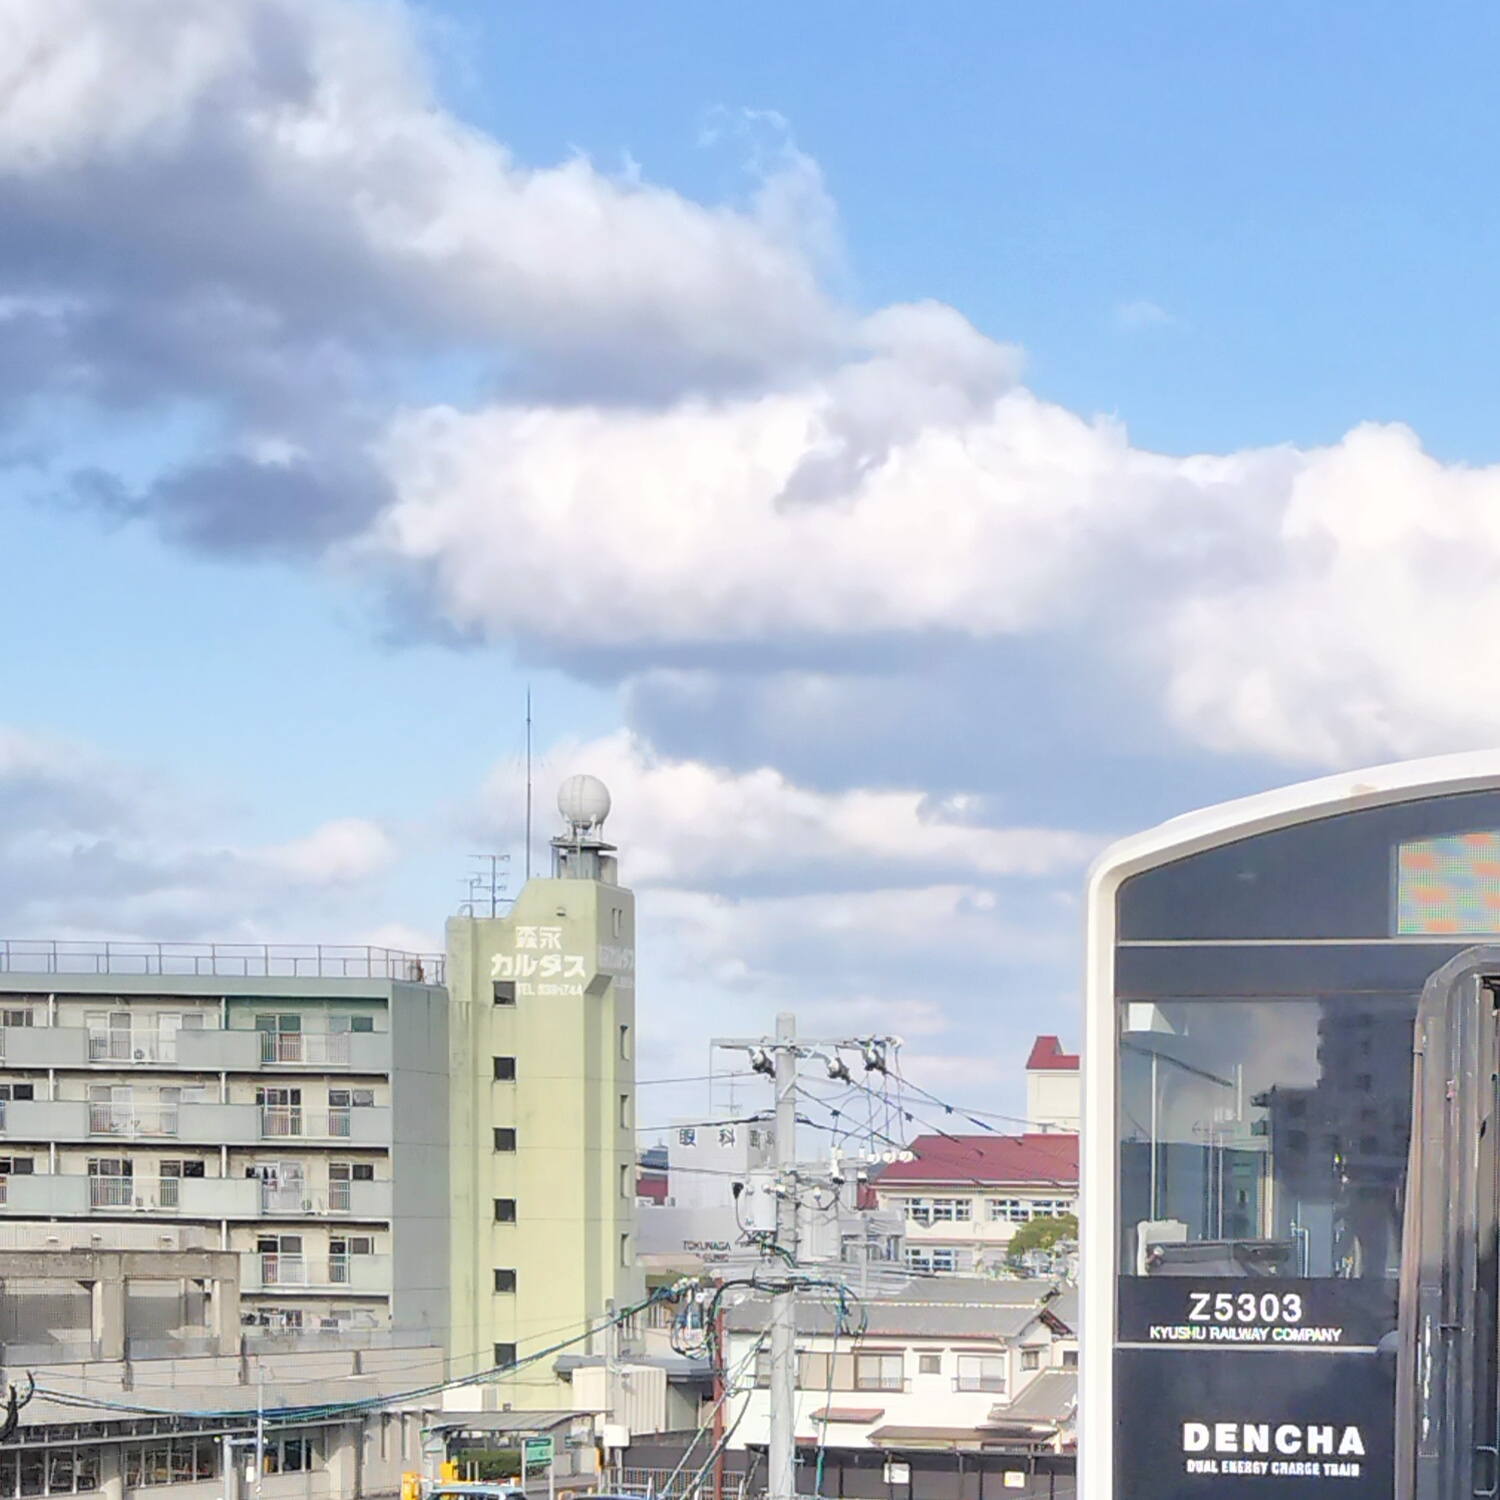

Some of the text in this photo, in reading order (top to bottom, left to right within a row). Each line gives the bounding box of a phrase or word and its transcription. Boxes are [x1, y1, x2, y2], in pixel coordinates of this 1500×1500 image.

[1189, 1293, 1302, 1322] Z5303
[1150, 1326, 1342, 1342] KYUSHU RAILWAY COMPANY
[1183, 1422, 1366, 1456] DENCHA
[1187, 1460, 1361, 1477] DUAL ENERGY CHARGE TRAIN
